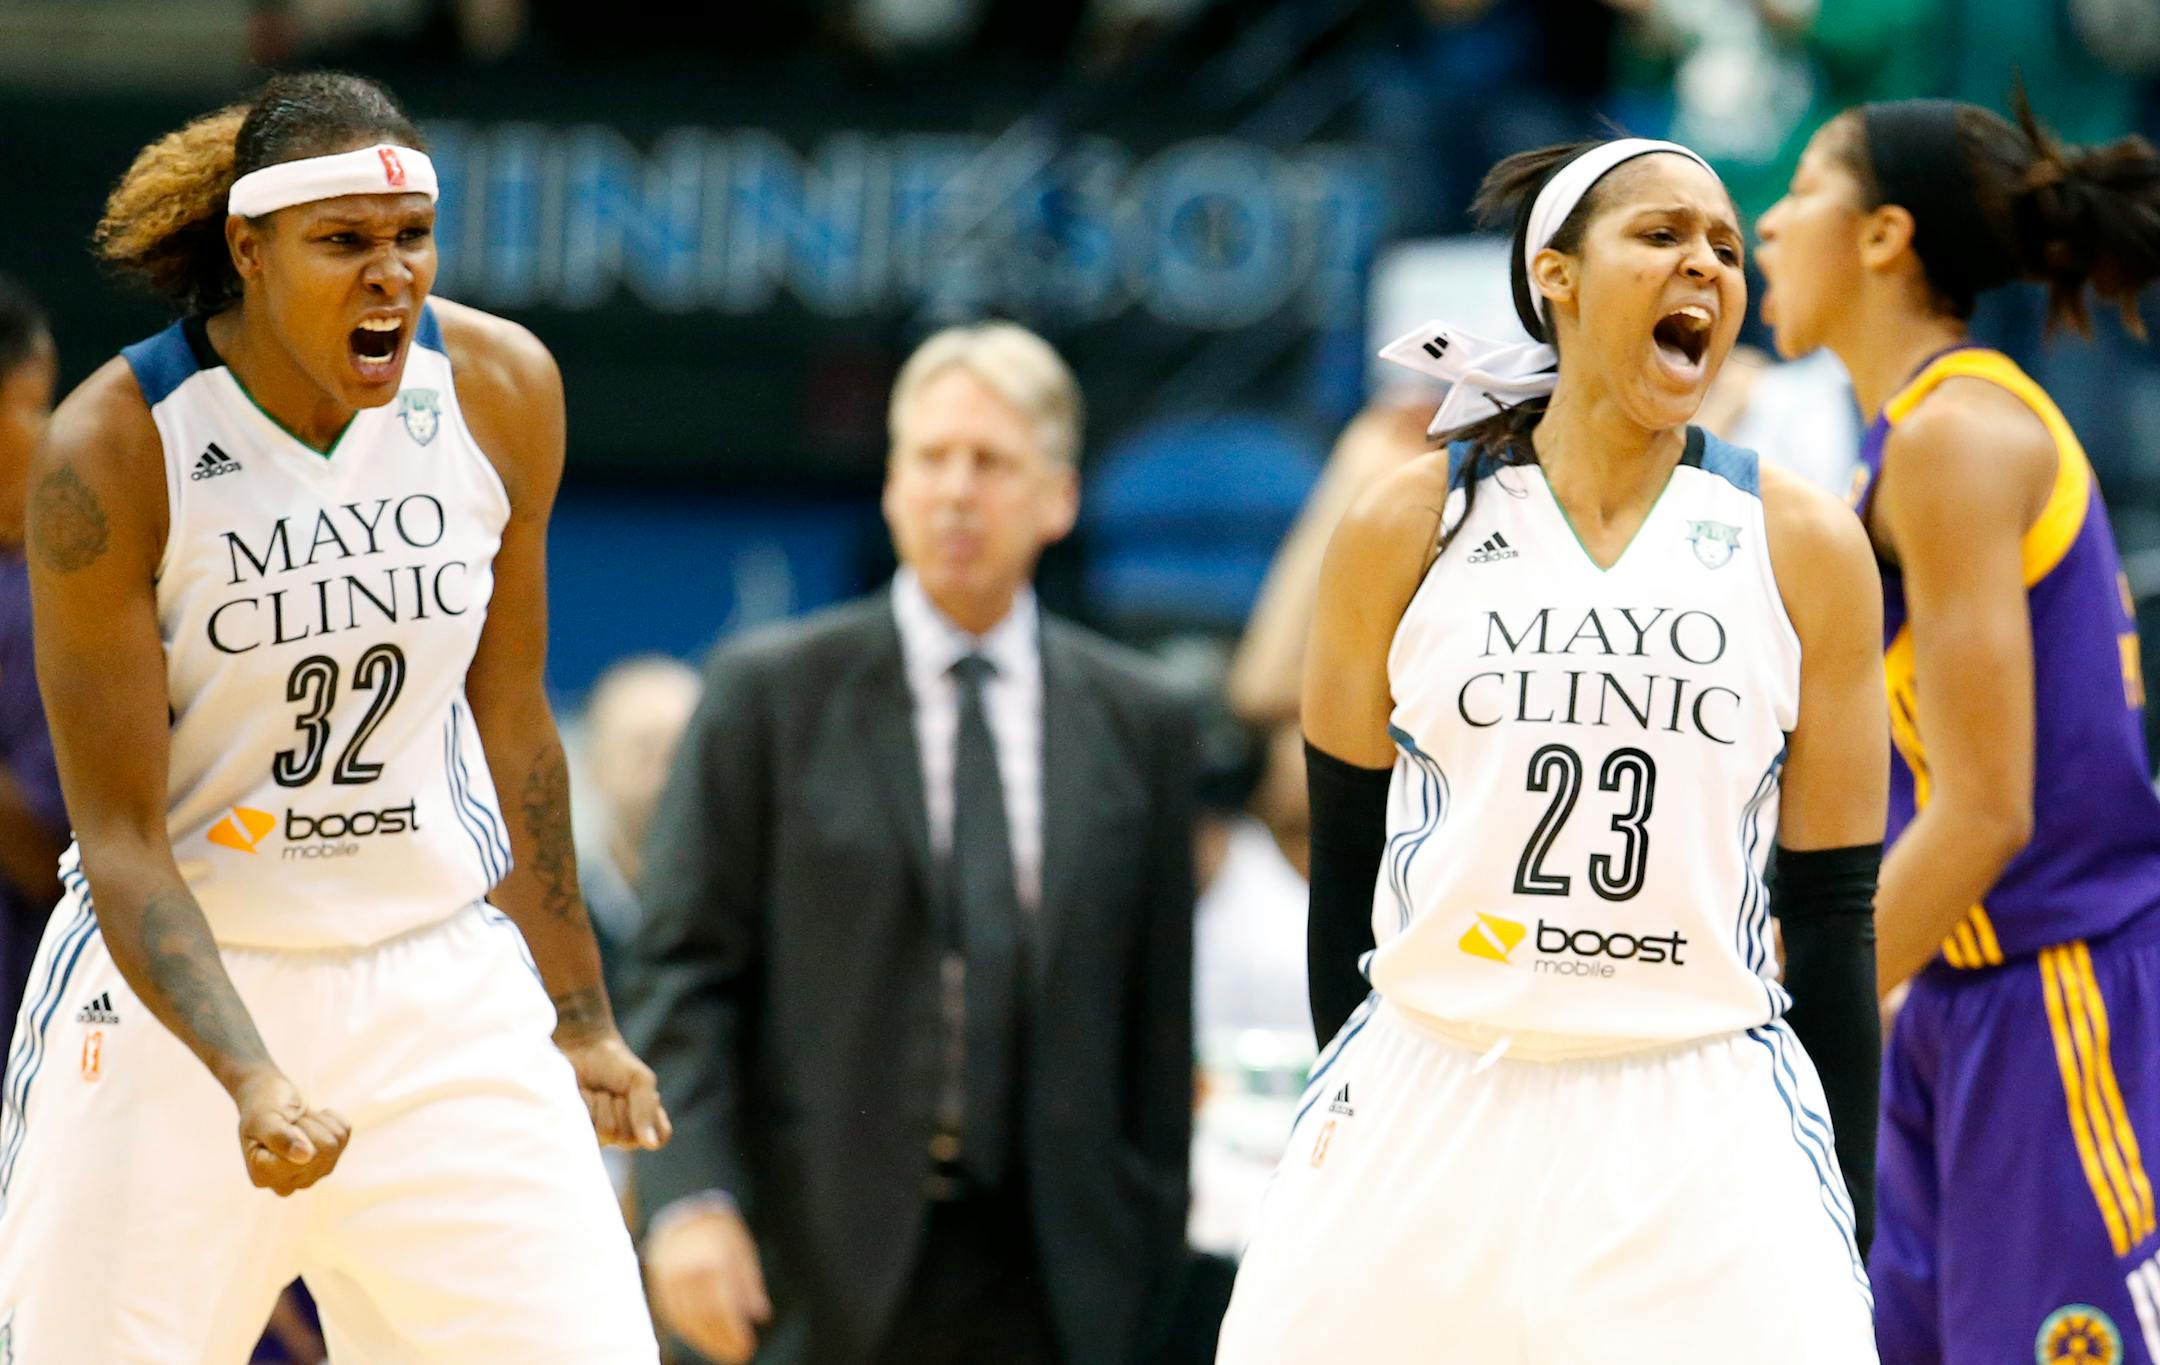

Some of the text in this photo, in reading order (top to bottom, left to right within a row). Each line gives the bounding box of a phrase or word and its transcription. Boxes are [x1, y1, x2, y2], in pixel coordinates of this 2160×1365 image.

[432, 118, 1395, 330] INNESOT
[191, 461, 243, 481] adidas
[219, 494, 444, 586] MAYO
[1467, 549, 1519, 564] adidas
[206, 561, 468, 654] CLINIC
[1477, 607, 1727, 665] MAYO
[272, 643, 406, 788] 32
[1457, 670, 1741, 745] CLINIC
[284, 797, 421, 841] boost
[1512, 743, 1657, 902] 23
[281, 841, 360, 860] mobile
[1533, 957, 1616, 979] mobile
[1535, 918, 1688, 966] boost
